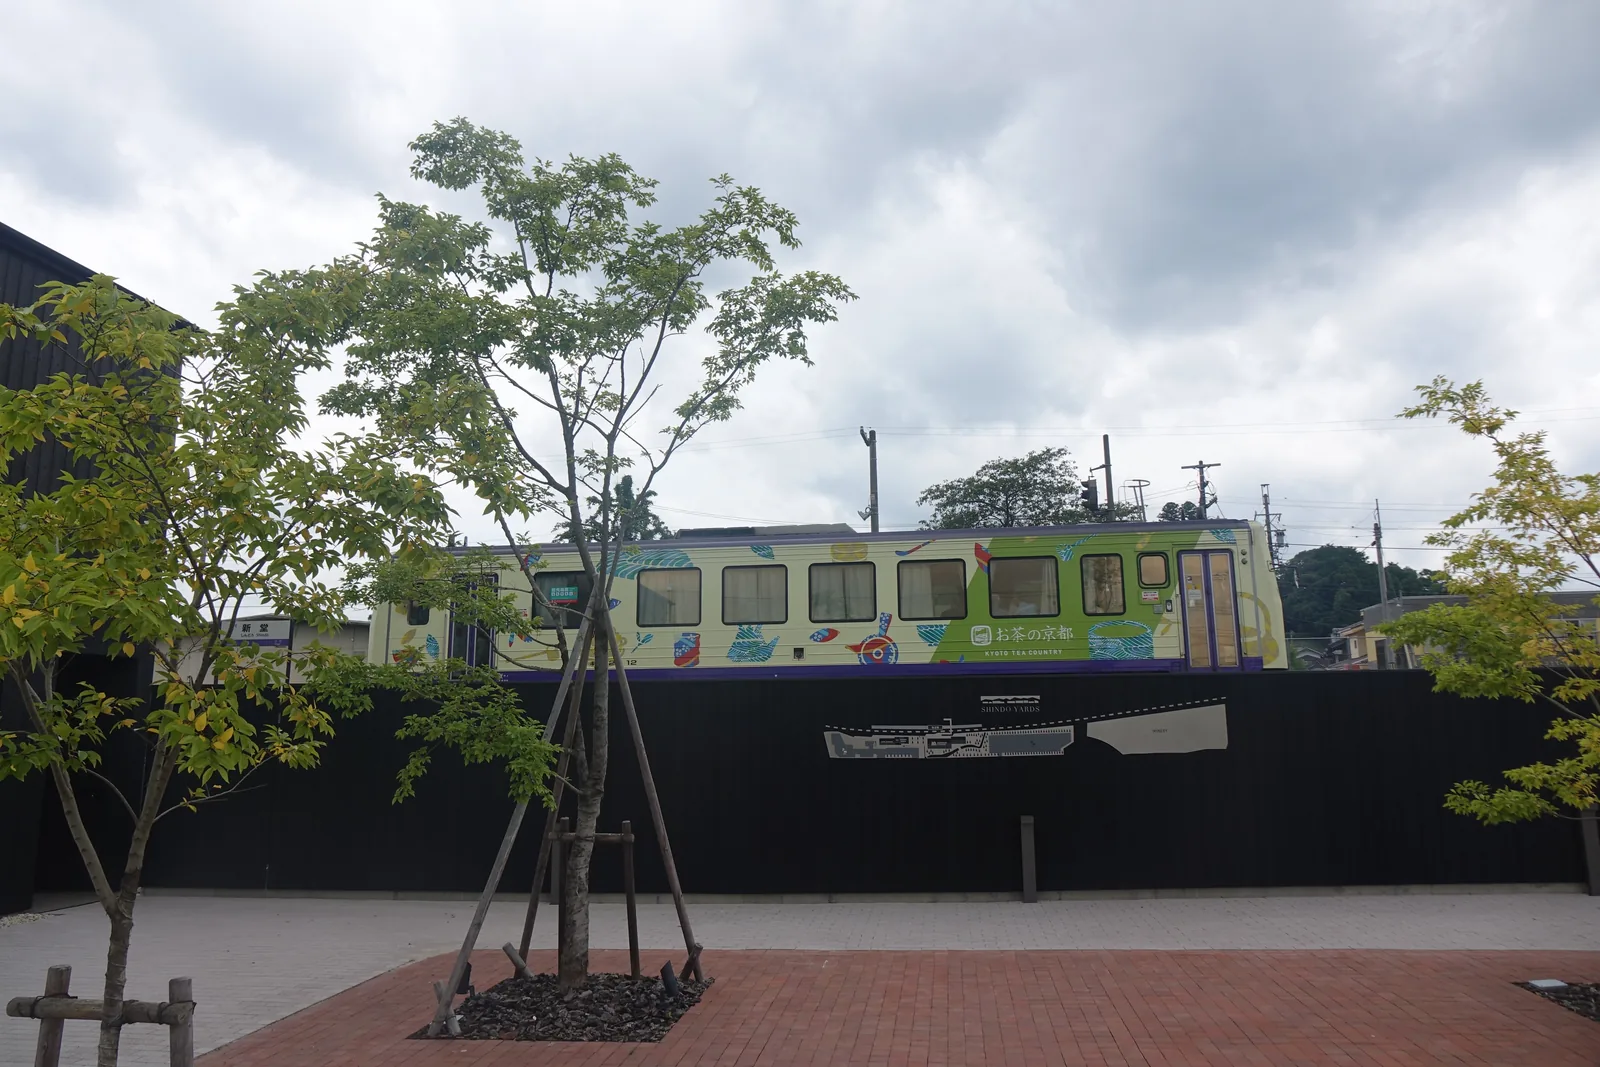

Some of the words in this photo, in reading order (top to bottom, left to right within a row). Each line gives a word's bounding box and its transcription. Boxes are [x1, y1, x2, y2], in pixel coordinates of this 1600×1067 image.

[242, 623, 269, 633] 新堂
[996, 625, 1074, 643] お茶の京都
